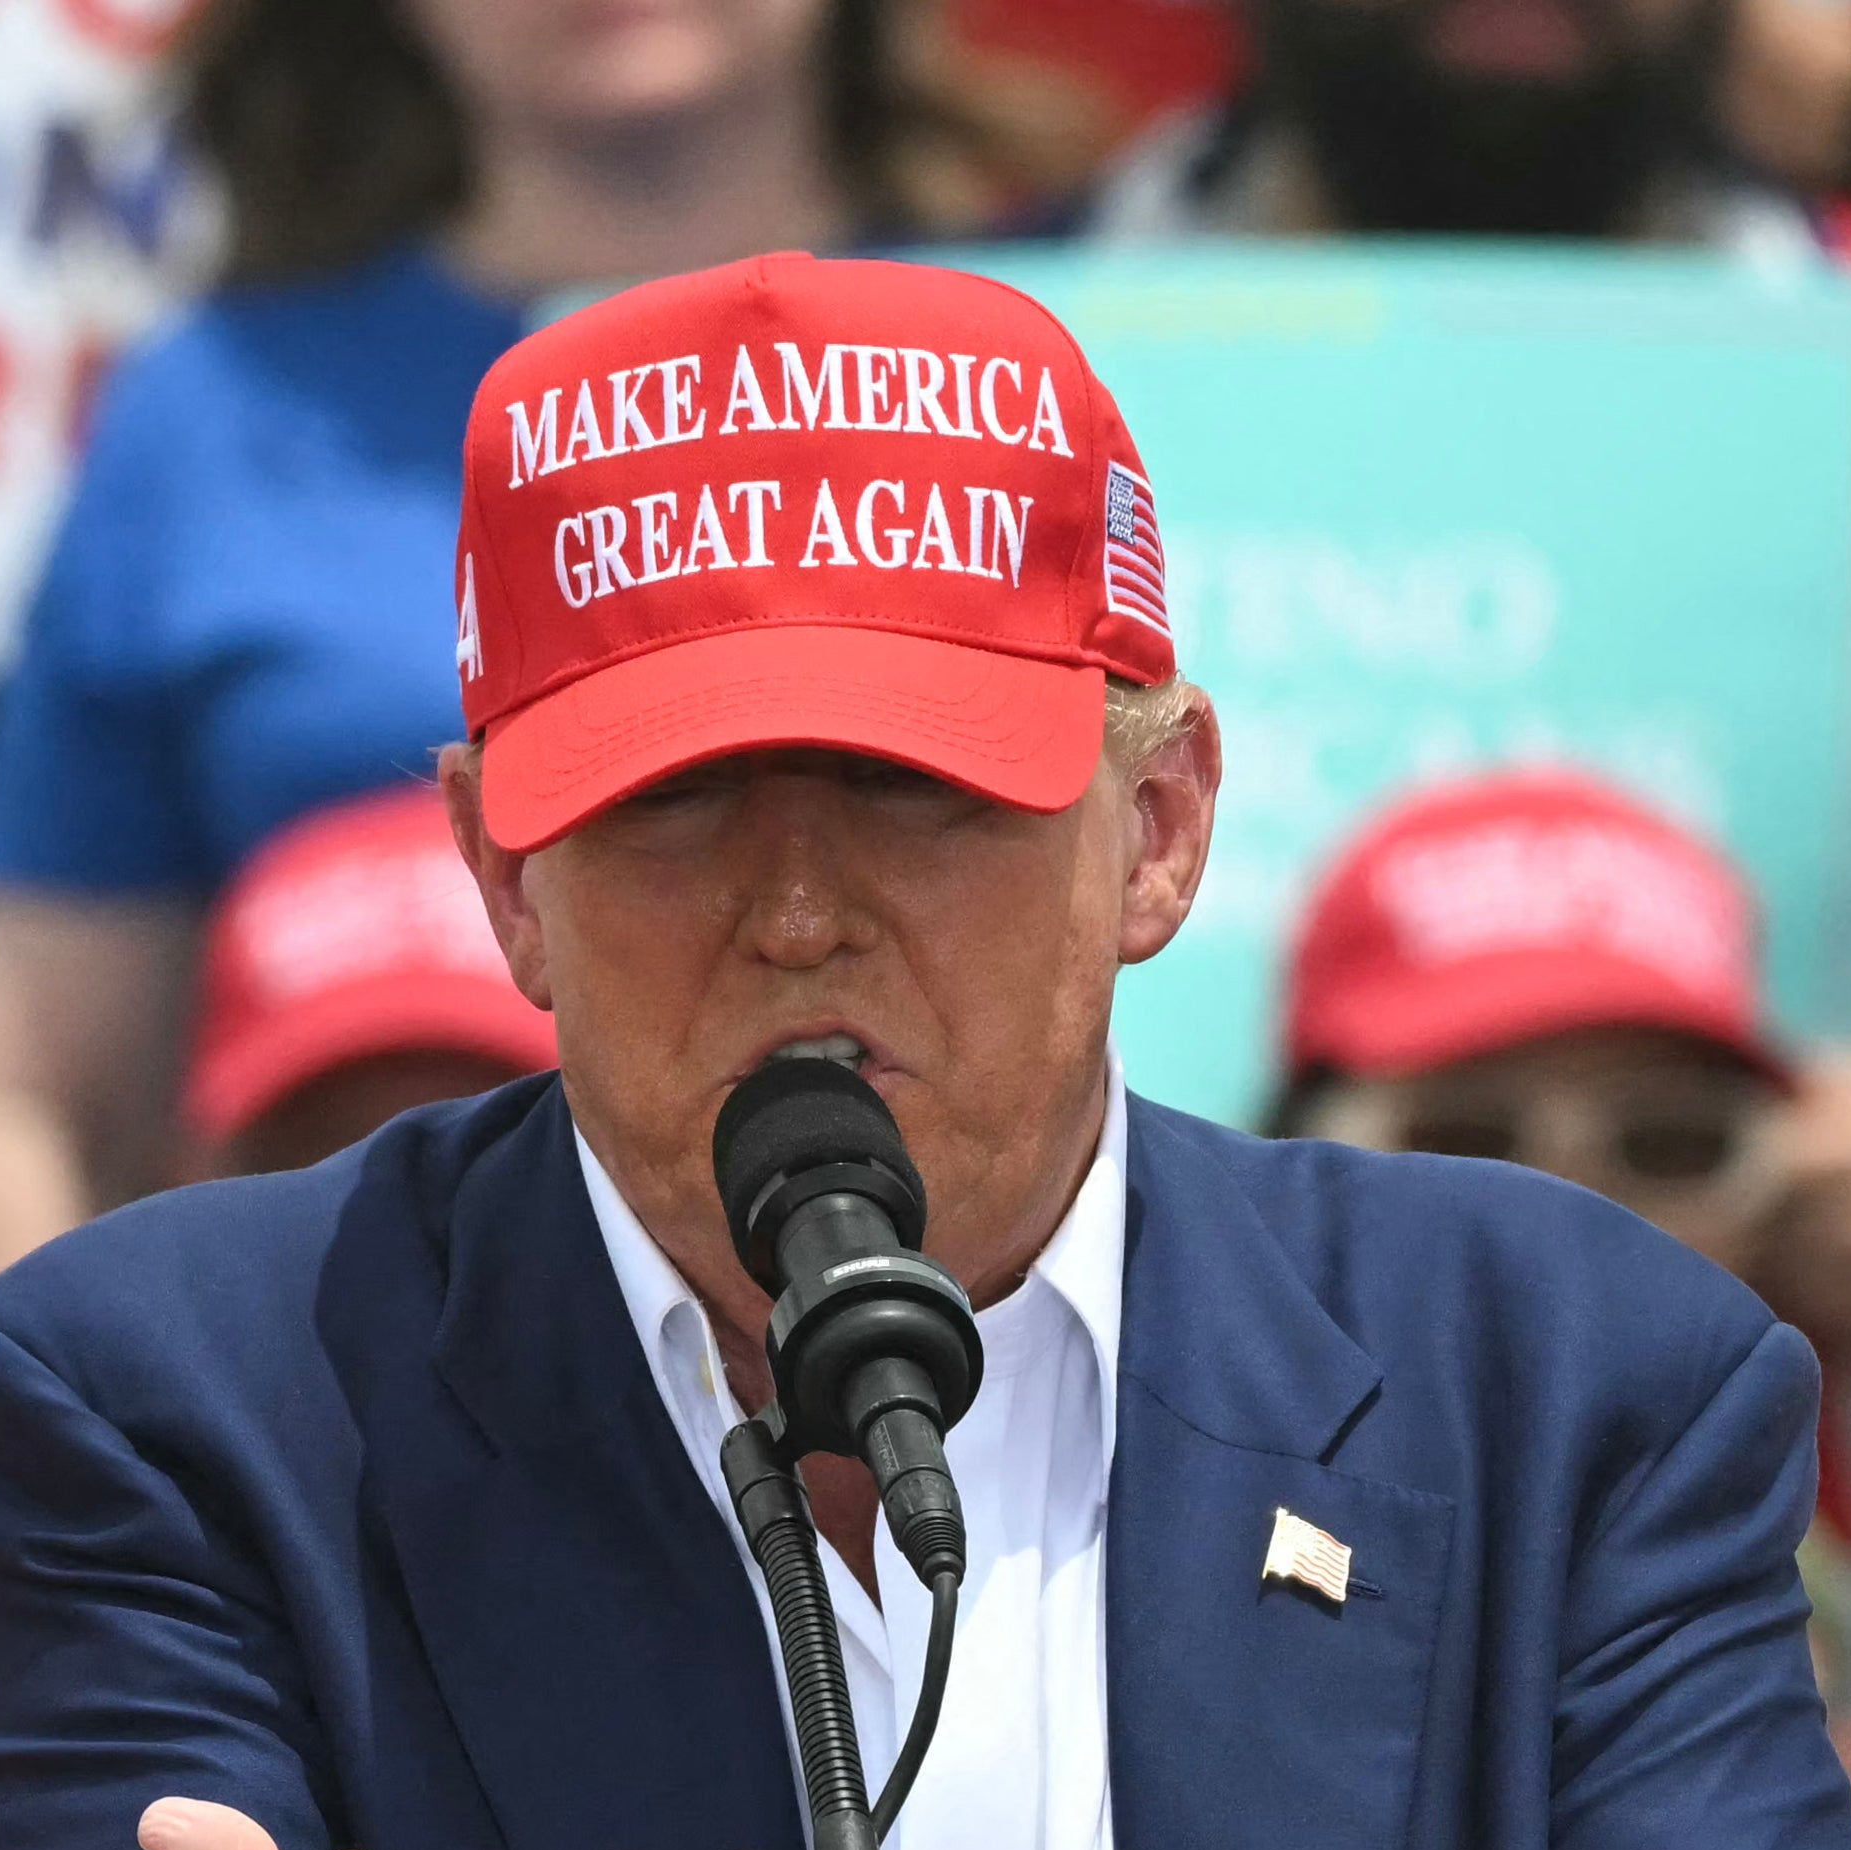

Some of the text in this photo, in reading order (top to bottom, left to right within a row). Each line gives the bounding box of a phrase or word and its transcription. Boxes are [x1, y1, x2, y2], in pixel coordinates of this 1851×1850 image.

[506, 342, 1074, 490] MAKE AMERICA
[555, 478, 1034, 608] GREAT AGAIN
[831, 1257, 891, 1278] SHURE
